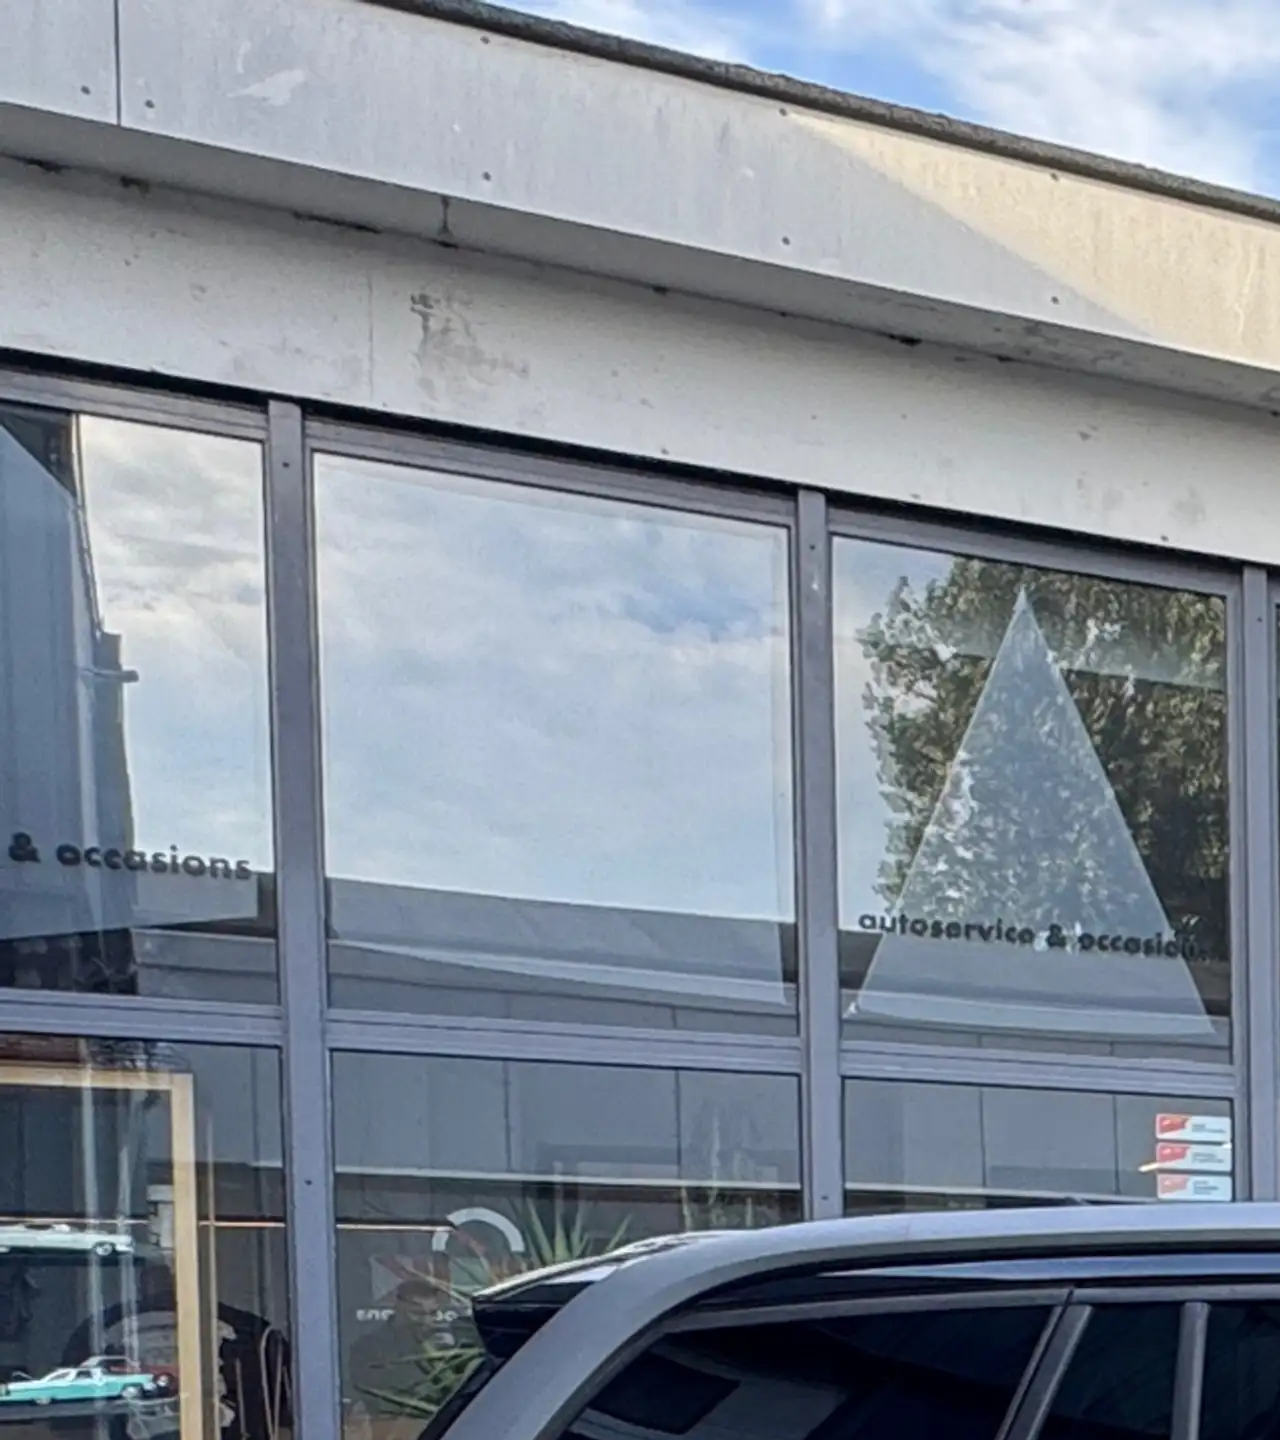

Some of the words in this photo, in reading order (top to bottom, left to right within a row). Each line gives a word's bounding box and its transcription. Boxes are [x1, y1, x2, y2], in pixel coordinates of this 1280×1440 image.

[8, 831, 41, 864] &
[56, 844, 252, 881] occasions
[858, 912, 1034, 944] autoservice
[1046, 924, 1067, 949] &
